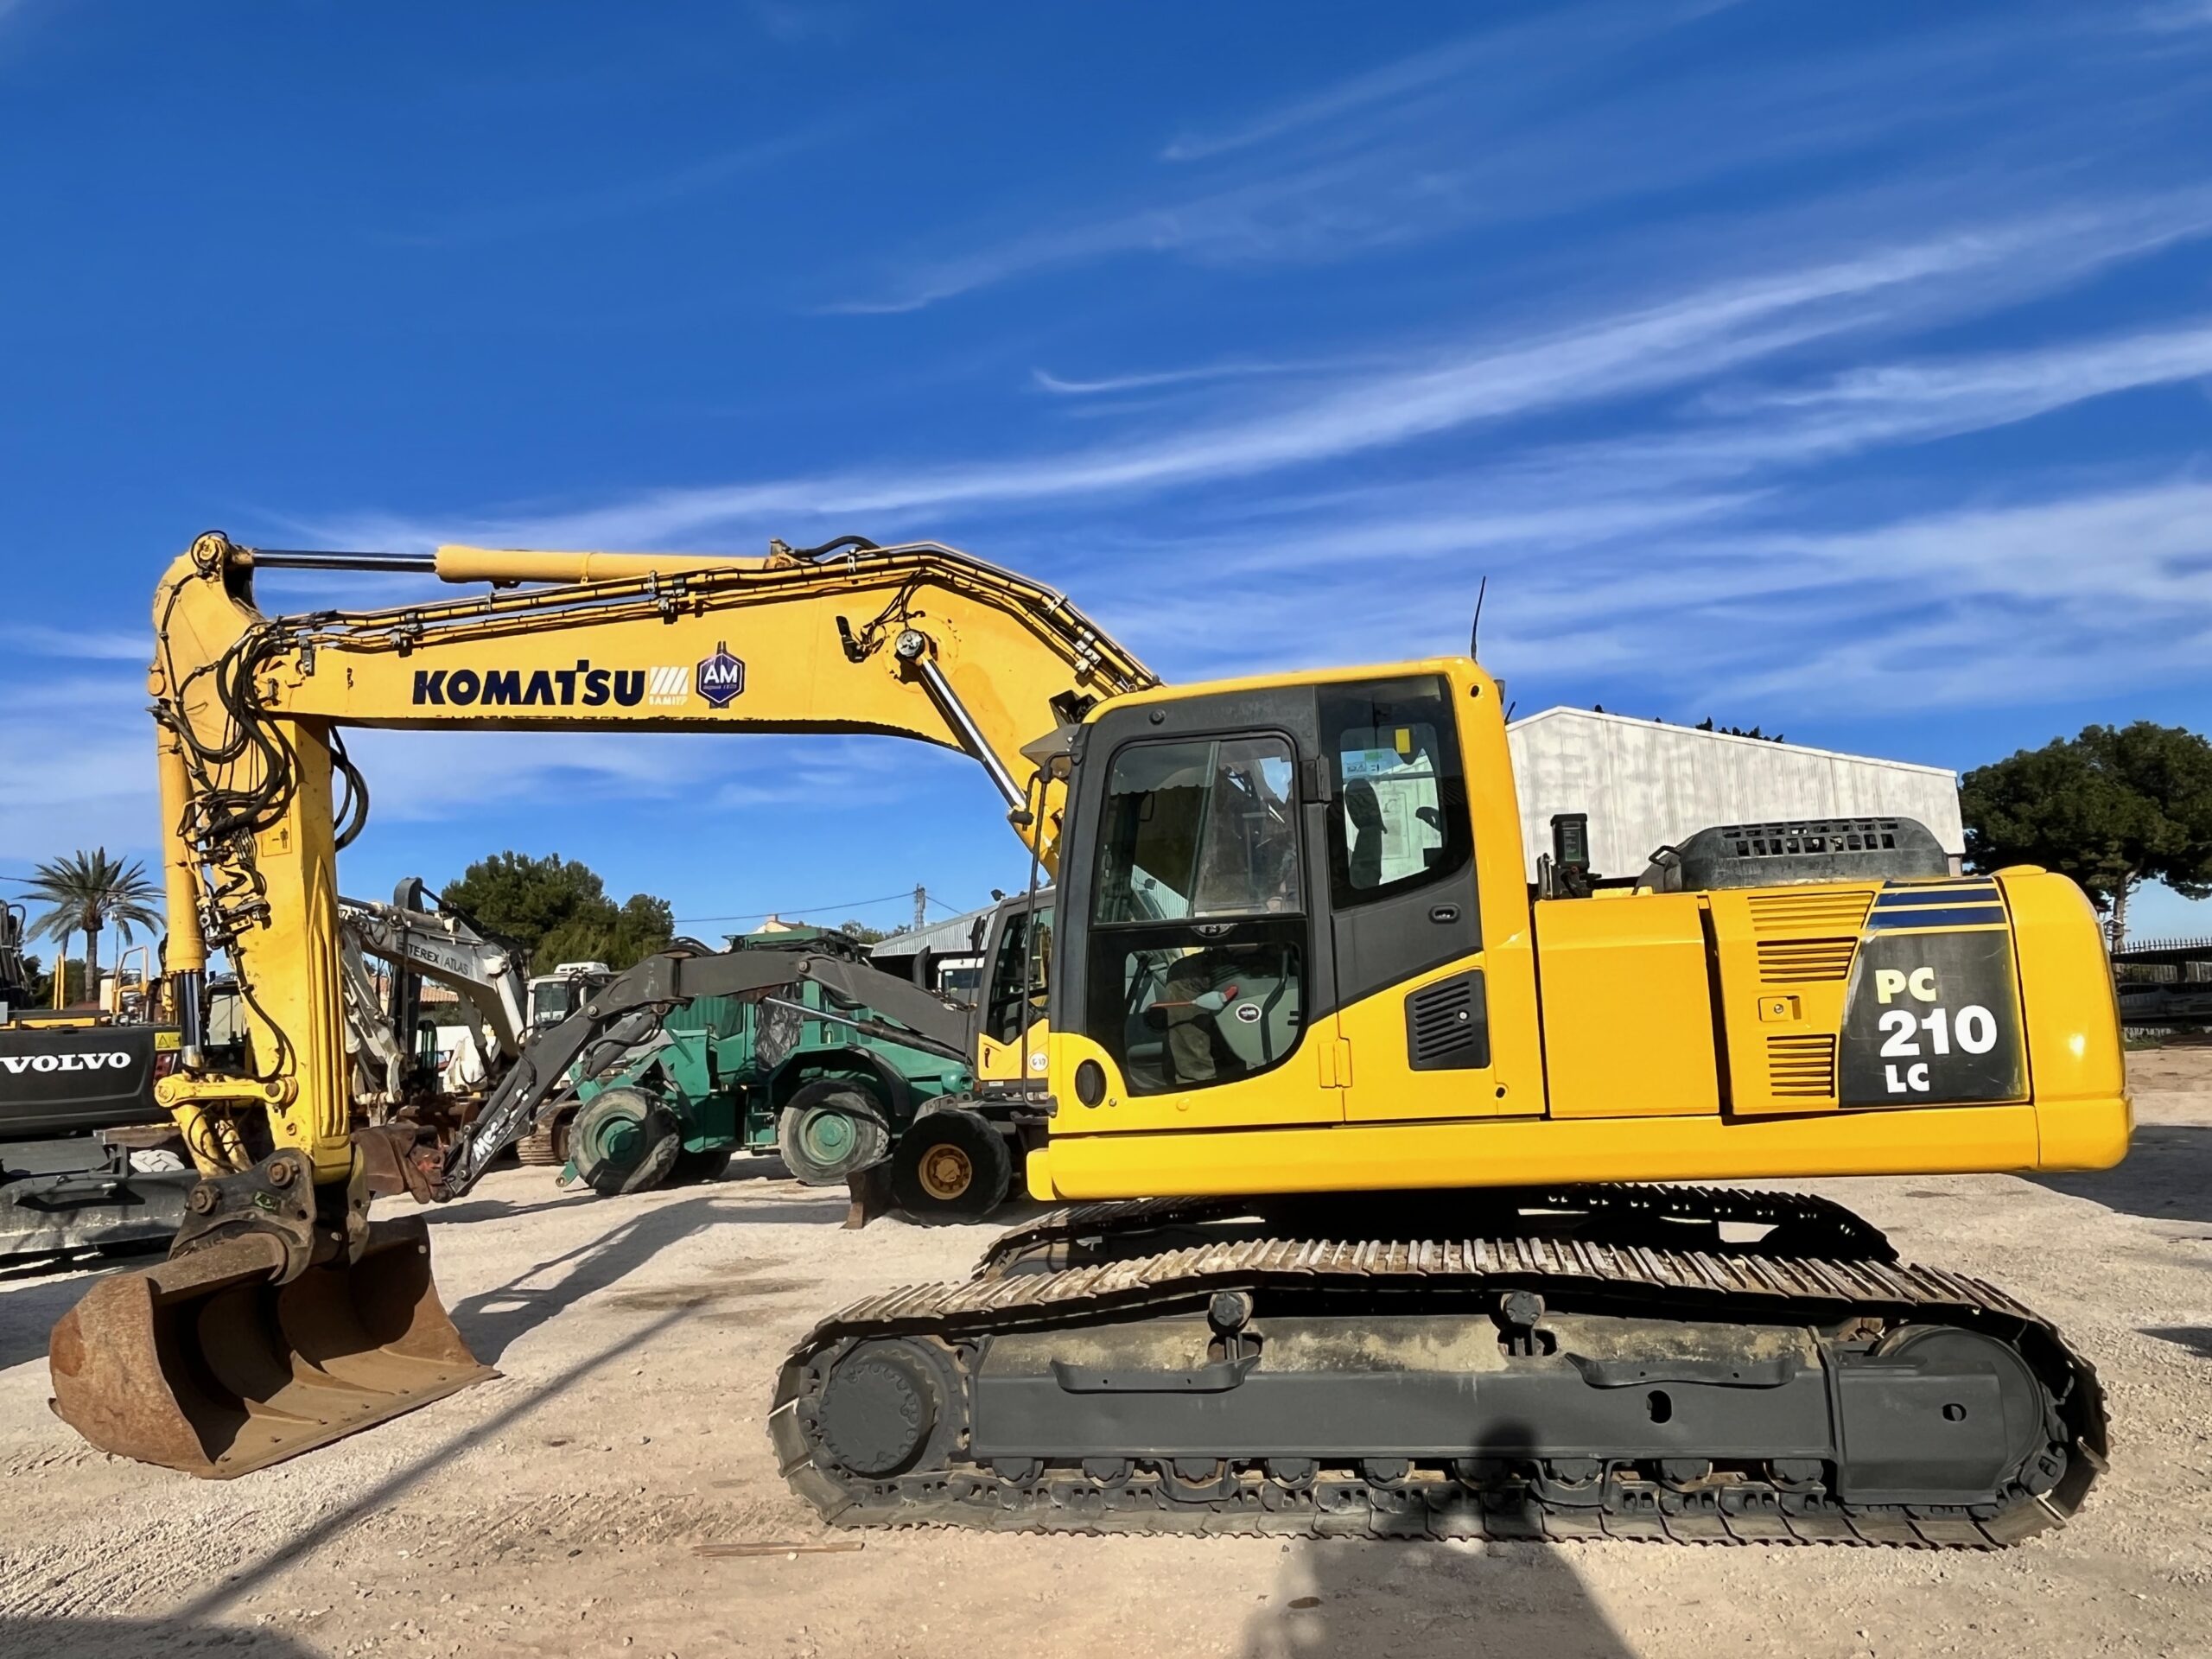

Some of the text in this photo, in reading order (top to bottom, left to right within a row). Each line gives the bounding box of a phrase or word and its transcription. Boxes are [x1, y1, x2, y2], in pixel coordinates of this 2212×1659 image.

[412, 659, 646, 707] KOMATSU
[703, 664, 738, 684] AM
[409, 944, 468, 976] TEREX ATLAS
[1875, 966, 1937, 1004] PC
[1878, 1004, 1998, 1058] 210
[0, 1052, 131, 1074] VOLVO
[1885, 1063, 1930, 1094] LC
